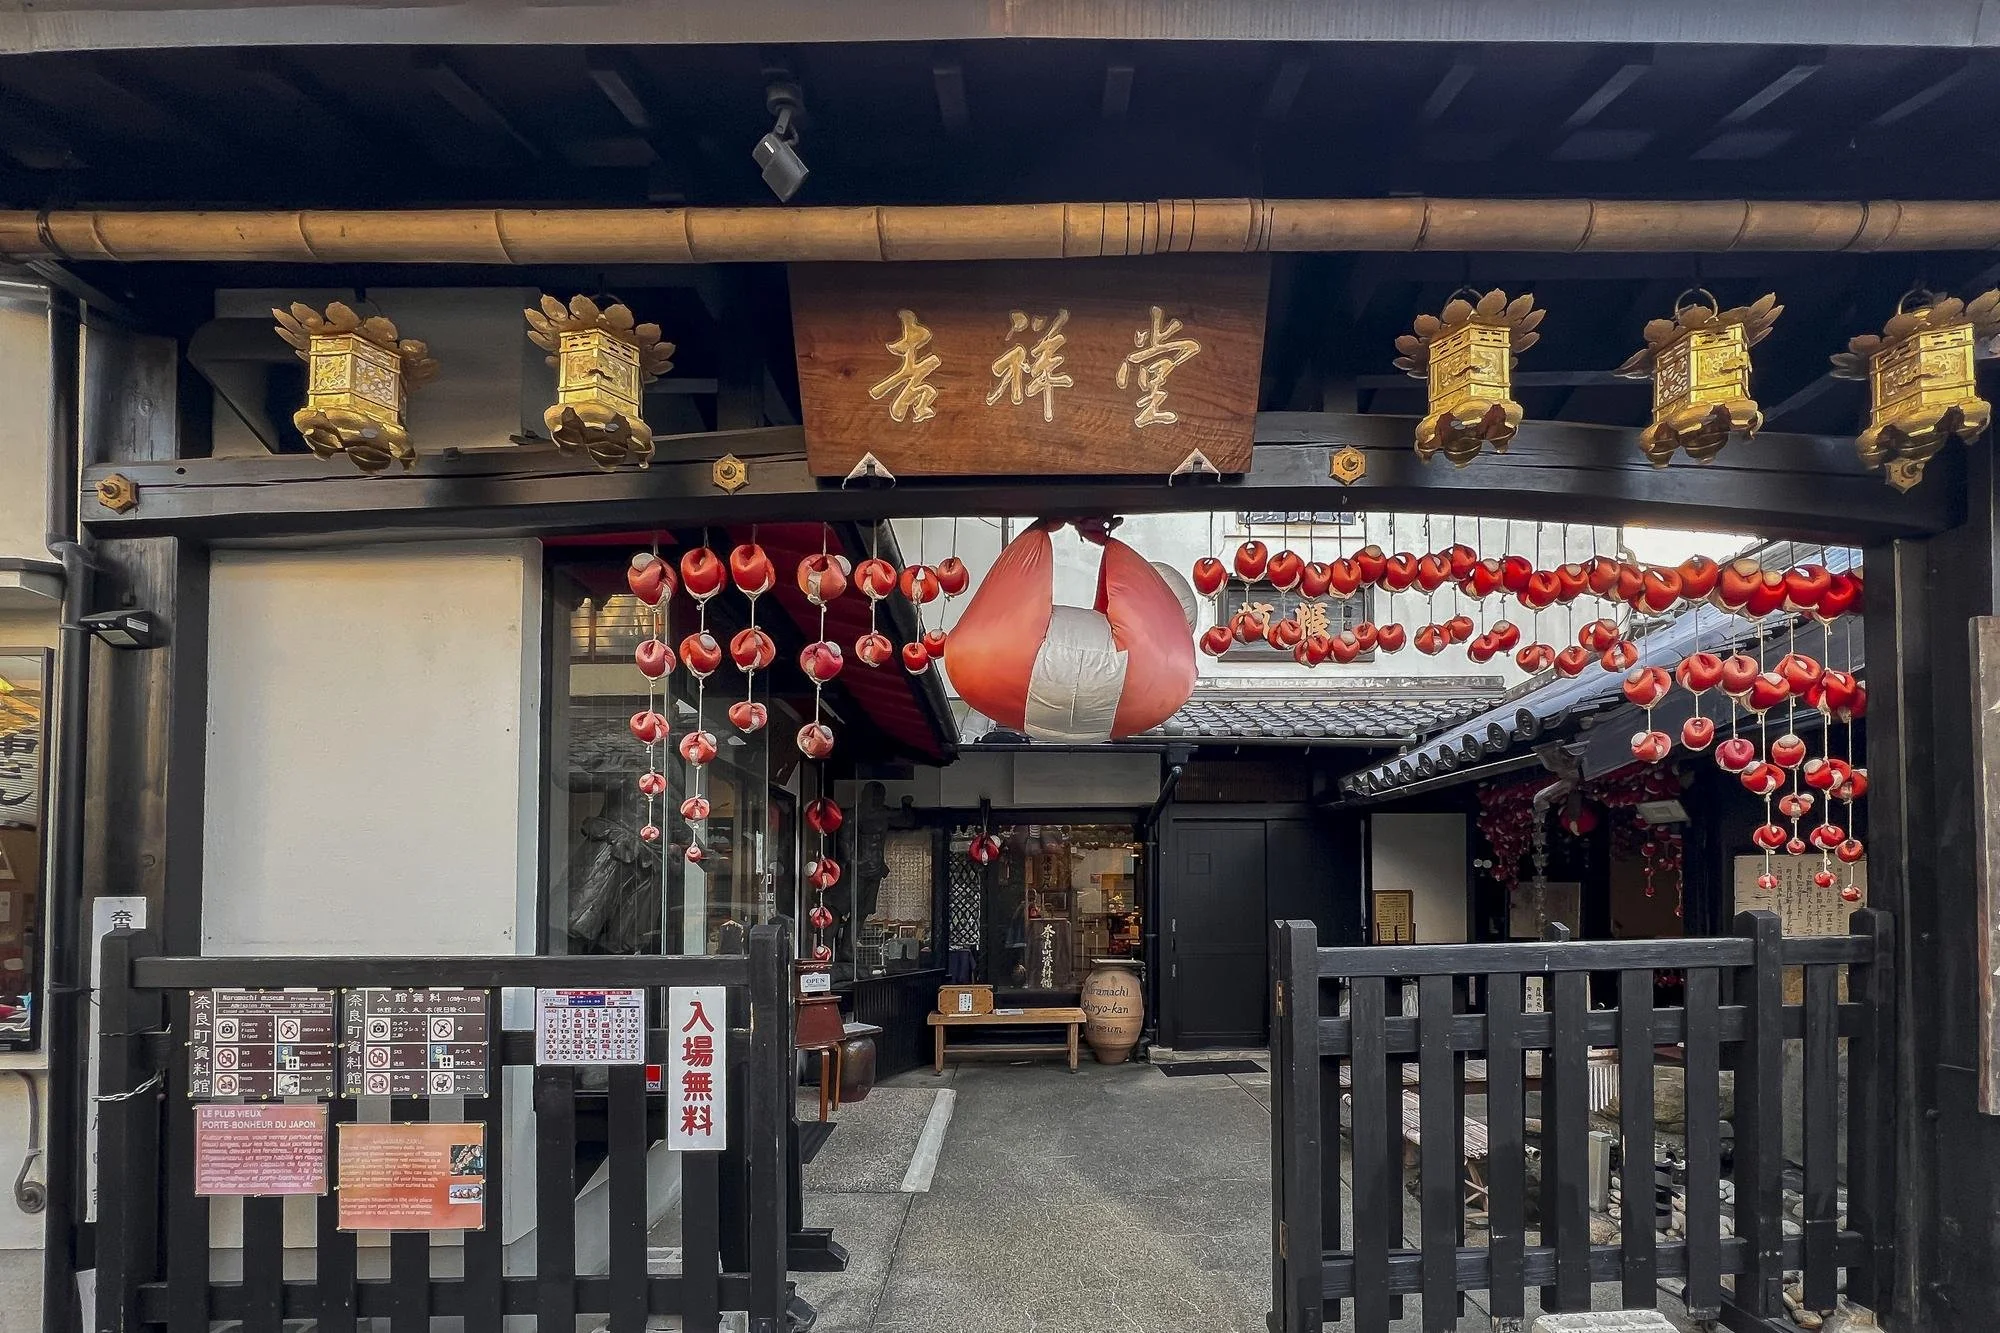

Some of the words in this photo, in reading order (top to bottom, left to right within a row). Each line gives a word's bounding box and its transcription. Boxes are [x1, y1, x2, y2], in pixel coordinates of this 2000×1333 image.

[869, 306, 1201, 428] 吉祥堂
[193, 995, 211, 1093] 奈良町資料館
[346, 994, 363, 1085] 奈良町資料館
[680, 1001, 715, 1136] 入場無料
[202, 1110, 211, 1118] LE
[214, 1110, 235, 1118] PLUS
[237, 1110, 262, 1118] VIEUX
[202, 1121, 273, 1129] PORTE-BONHEUR
[275, 1121, 287, 1129] DU
[288, 1121, 316, 1129] JAPON
